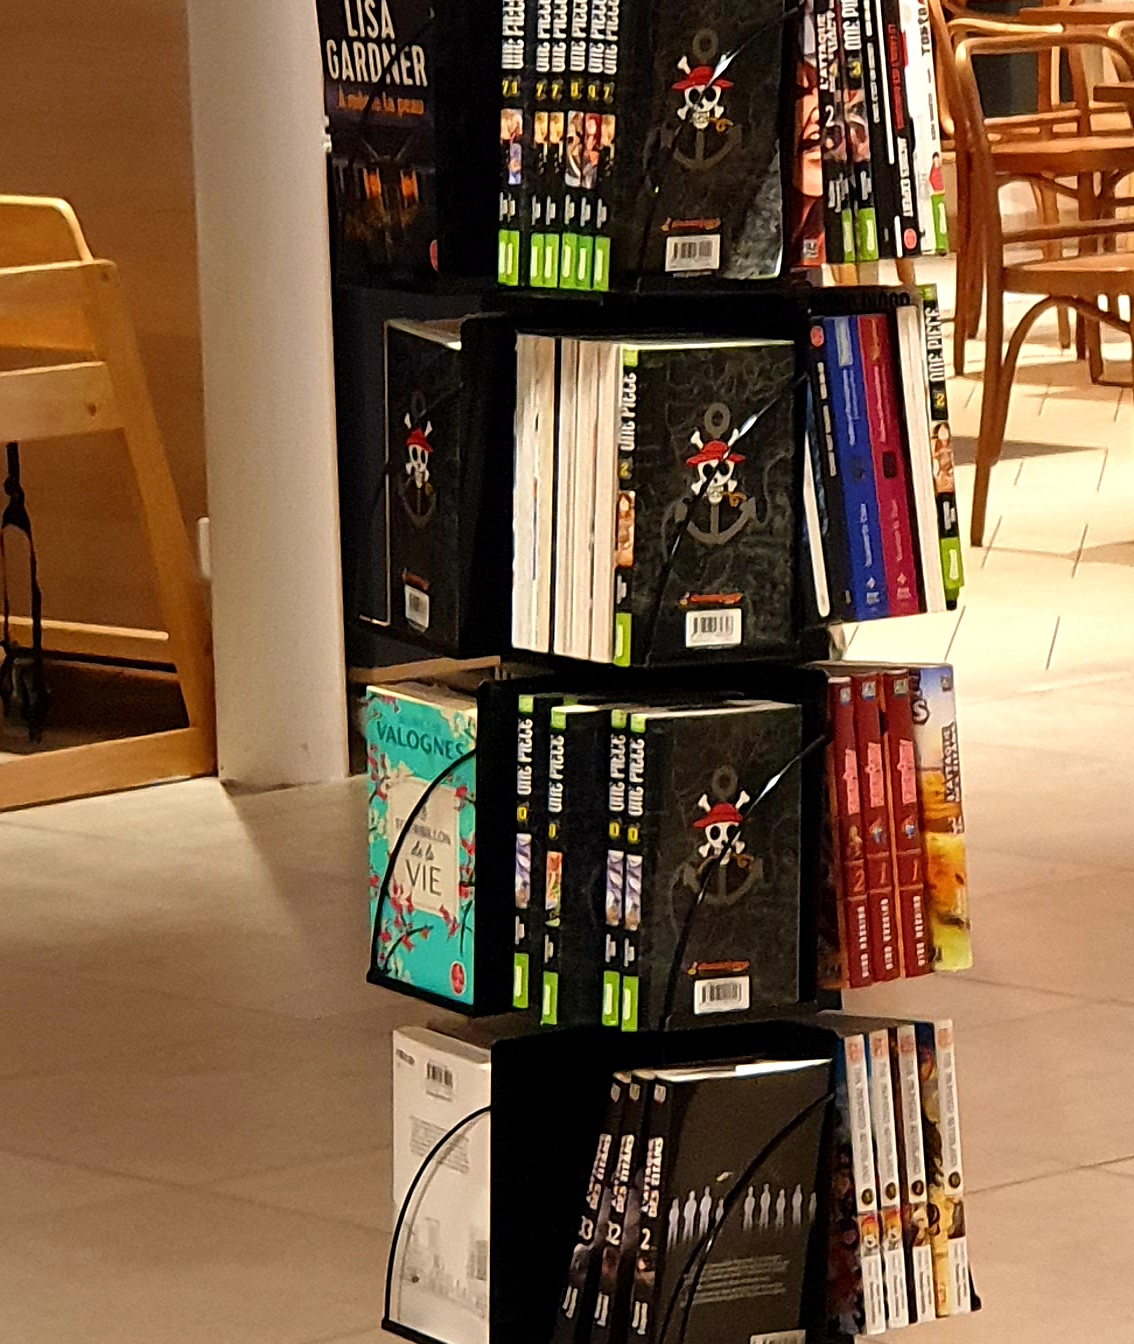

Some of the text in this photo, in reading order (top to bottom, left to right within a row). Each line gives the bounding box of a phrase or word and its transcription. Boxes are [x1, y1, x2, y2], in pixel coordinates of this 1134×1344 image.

[326, 39, 428, 87] GARDNER
[376, 721, 465, 760] VALOGNES
[405, 859, 443, 896] VIE
